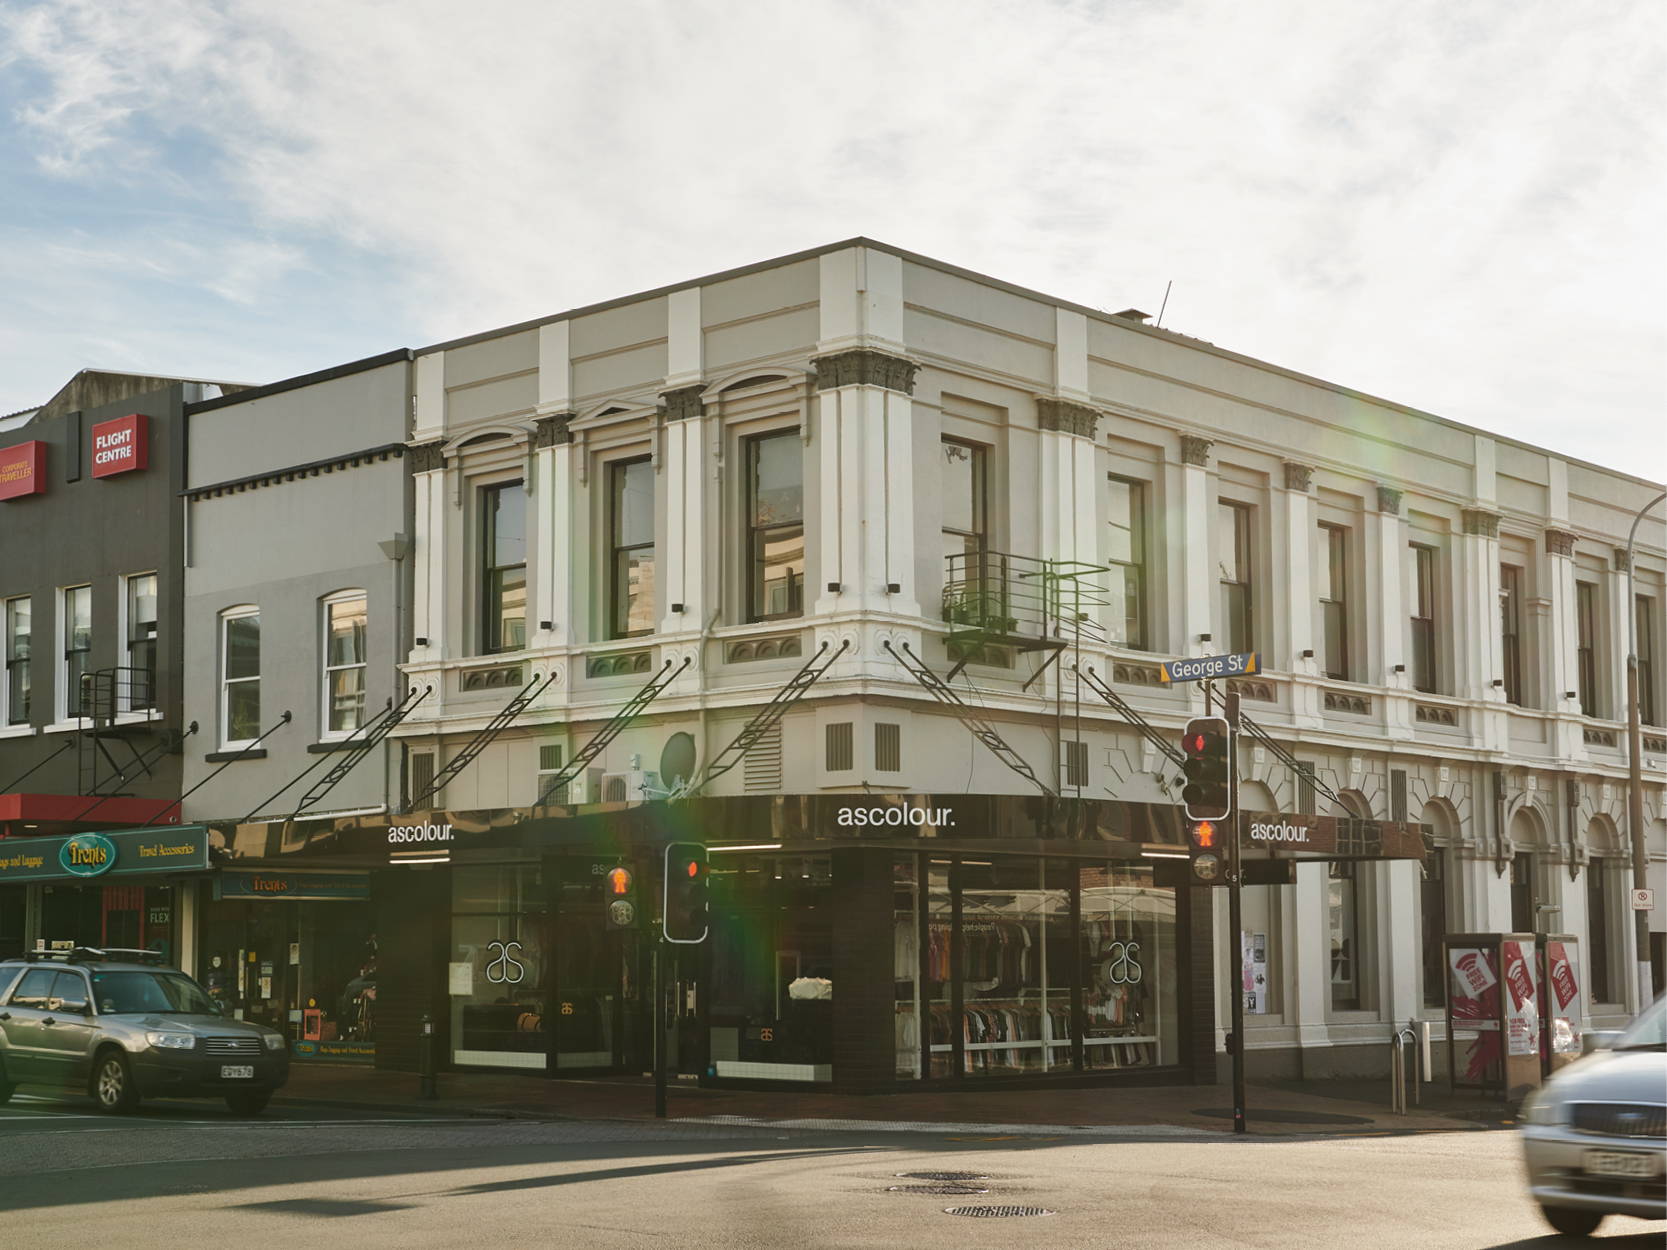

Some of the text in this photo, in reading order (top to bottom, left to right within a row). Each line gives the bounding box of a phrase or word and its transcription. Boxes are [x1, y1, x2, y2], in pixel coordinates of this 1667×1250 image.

[96, 429, 132, 449] FLIGHT
[95, 445, 132, 464] CENTRE
[1172, 655, 1244, 678] George St
[837, 802, 956, 826] ascolour.
[388, 820, 455, 843] ascolour.
[1250, 820, 1310, 843] ascolour.
[69, 841, 107, 868] Trents
[150, 912, 169, 924] FLEX
